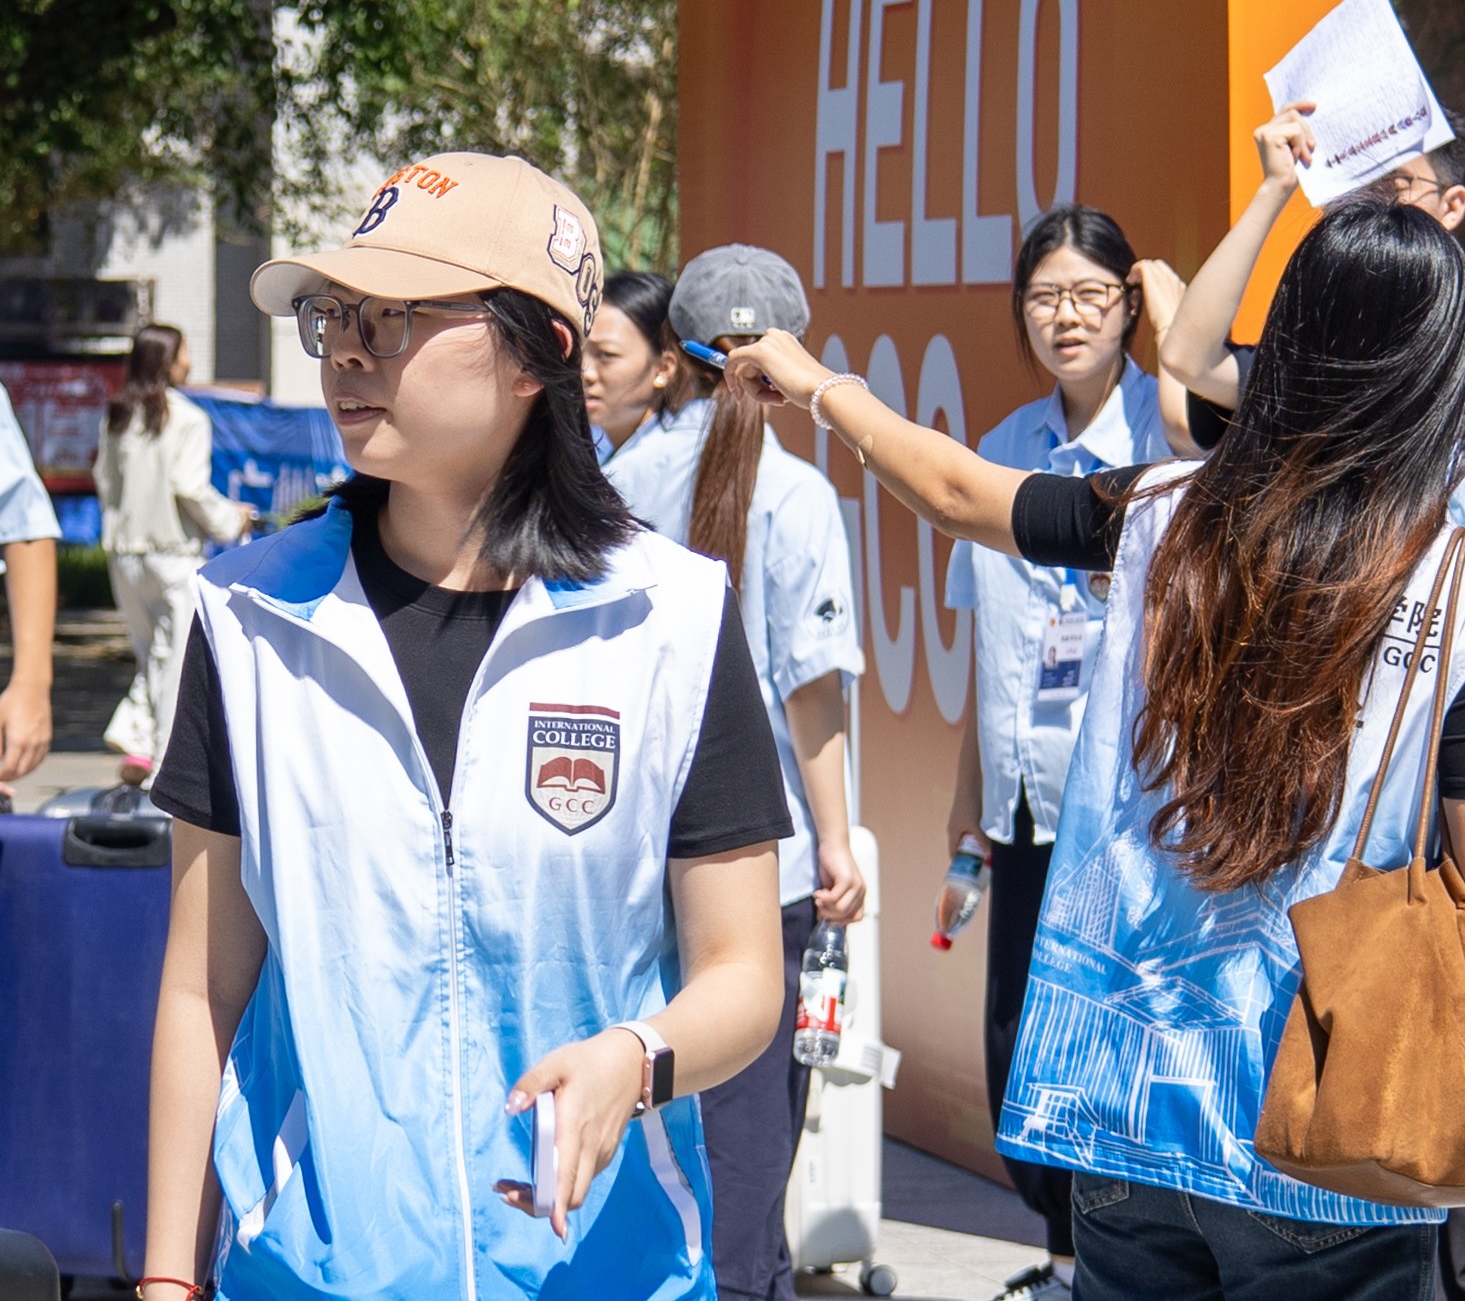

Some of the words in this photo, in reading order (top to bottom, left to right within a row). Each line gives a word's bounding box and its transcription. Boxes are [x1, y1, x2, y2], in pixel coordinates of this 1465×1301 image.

[369, 164, 460, 201] TON
[534, 720, 615, 734] INTERNATIONAL
[532, 730, 616, 749] COLLEGE
[548, 796, 595, 815] GCC
[1037, 936, 1107, 975] TERNATIONAL
